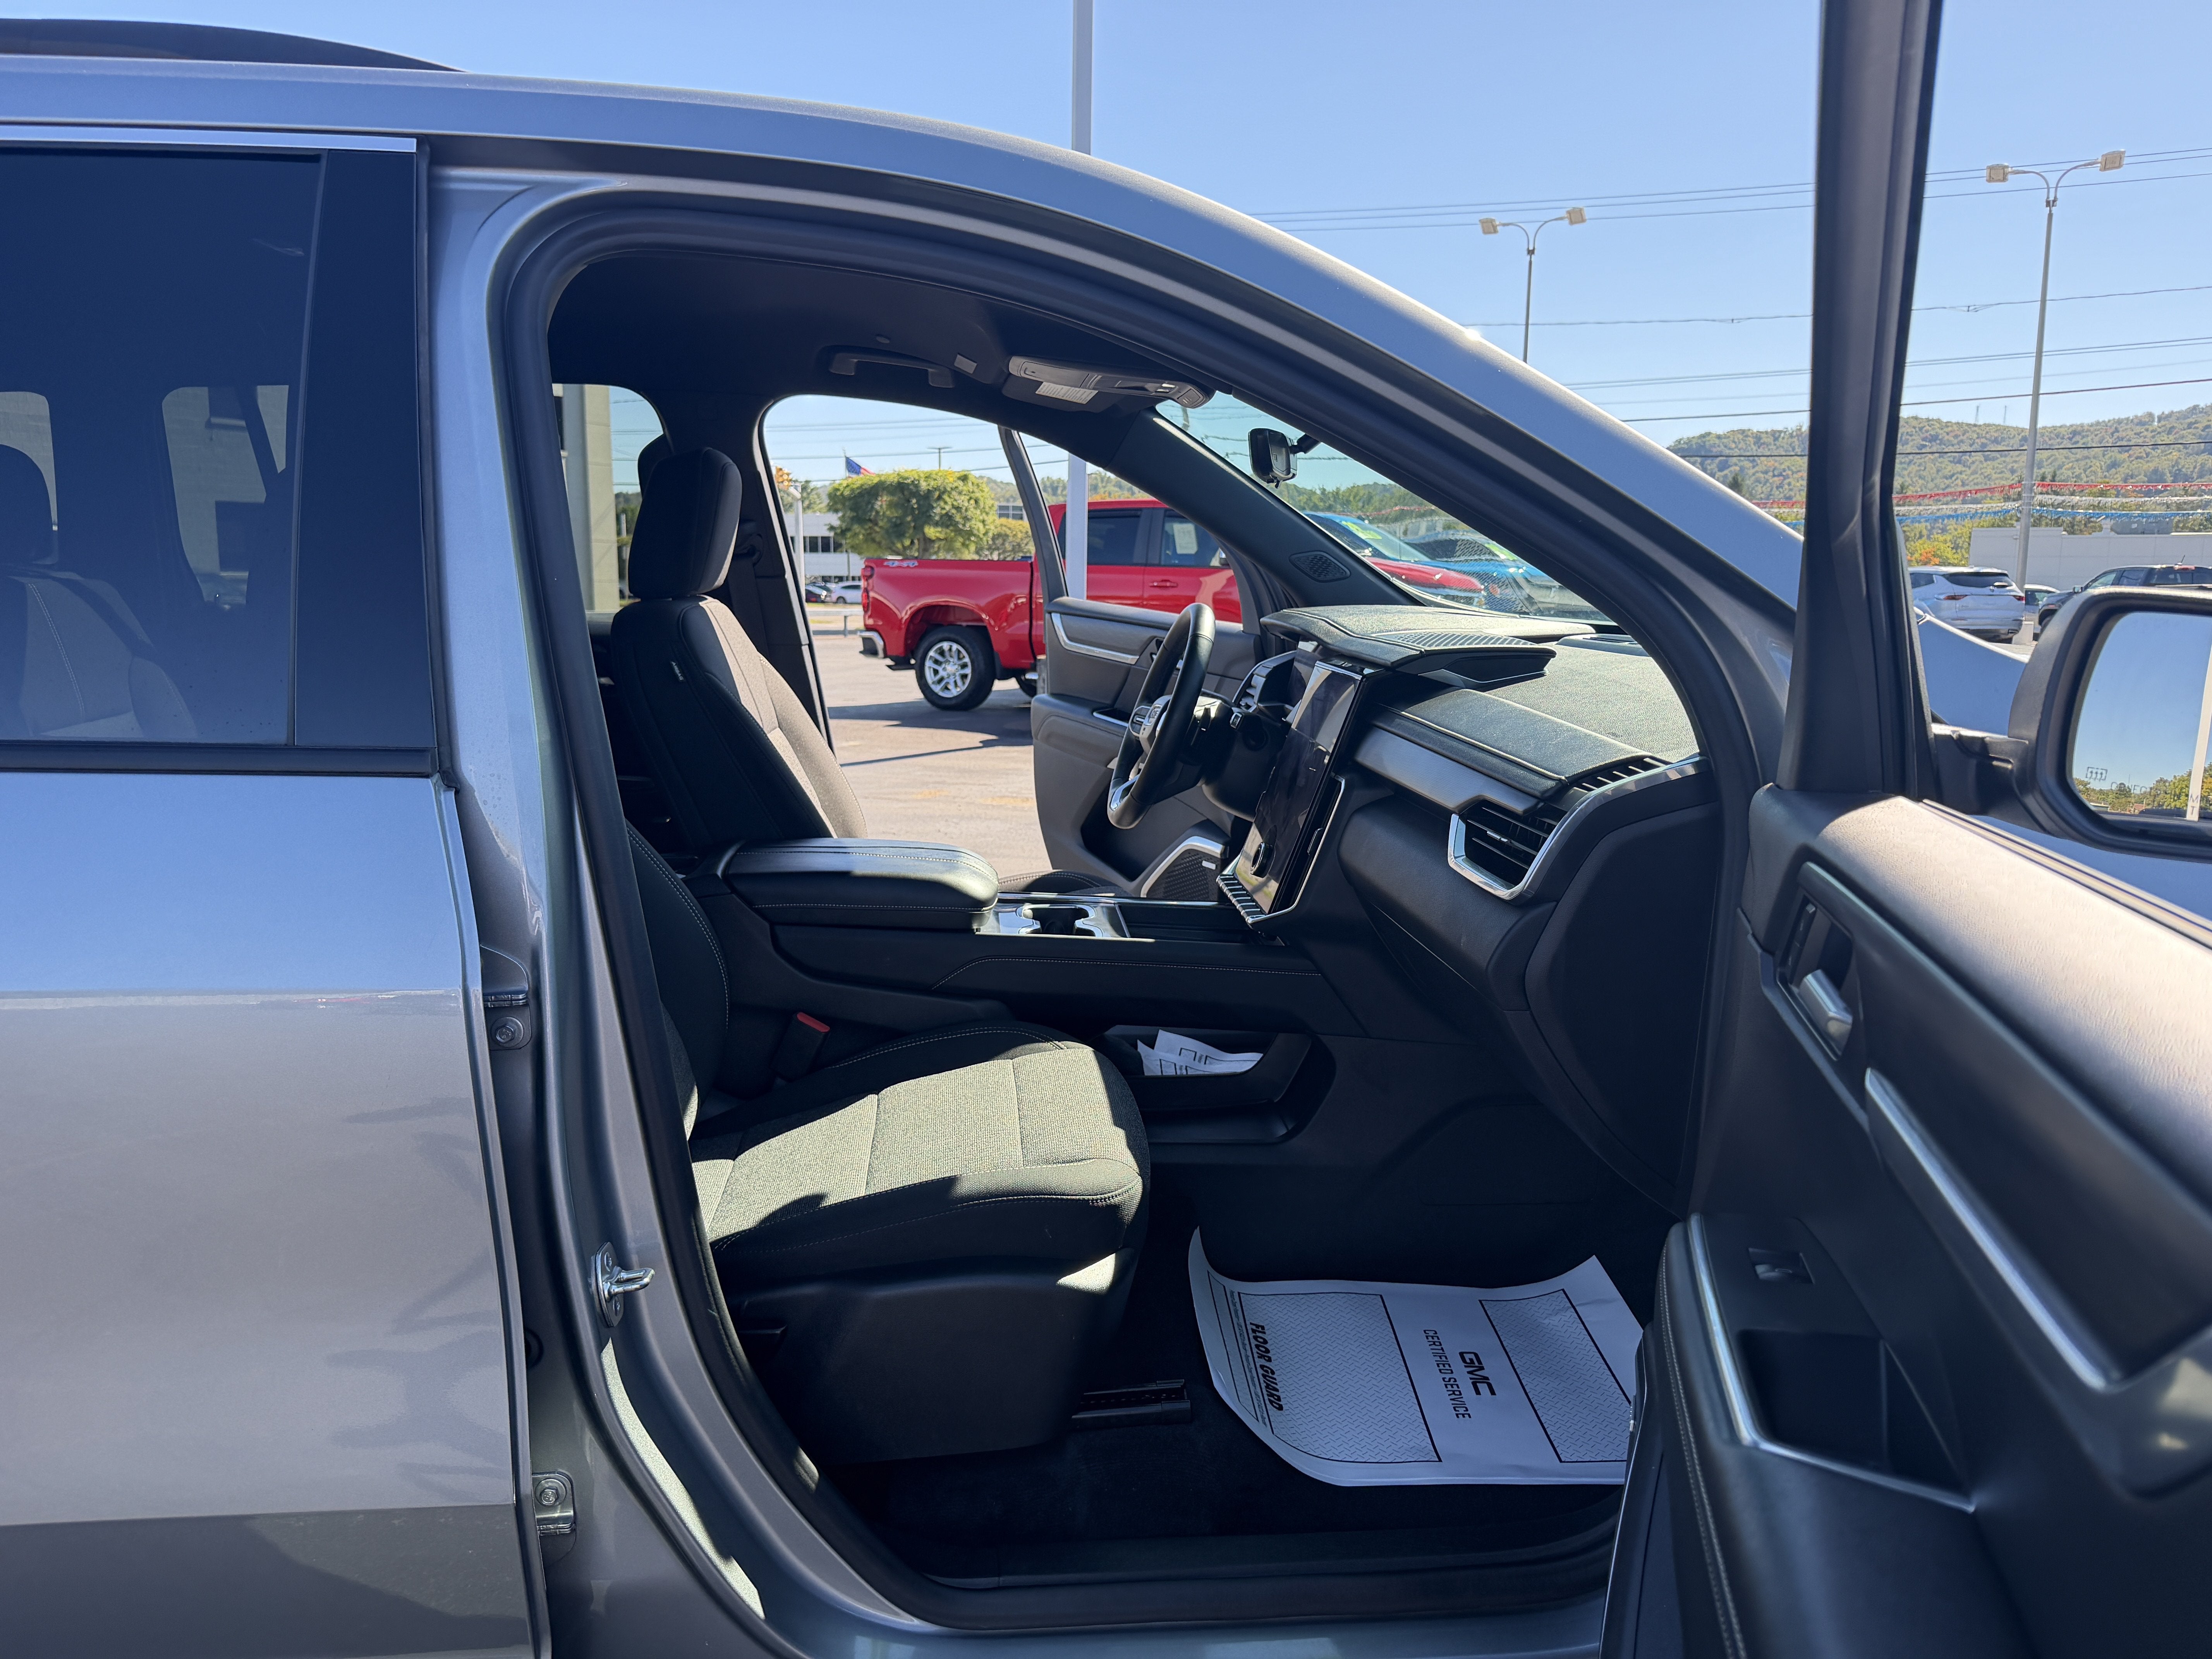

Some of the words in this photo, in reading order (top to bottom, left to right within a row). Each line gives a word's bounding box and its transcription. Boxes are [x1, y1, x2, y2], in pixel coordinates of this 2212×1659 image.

[1249, 1322, 1272, 1363] FLOOR
[1259, 1364, 1283, 1411] GUARD
[1423, 1329, 1454, 1374] CERTIFIED
[1442, 1377, 1472, 1419] SERVICE
[1458, 1351, 1496, 1396] GMC
